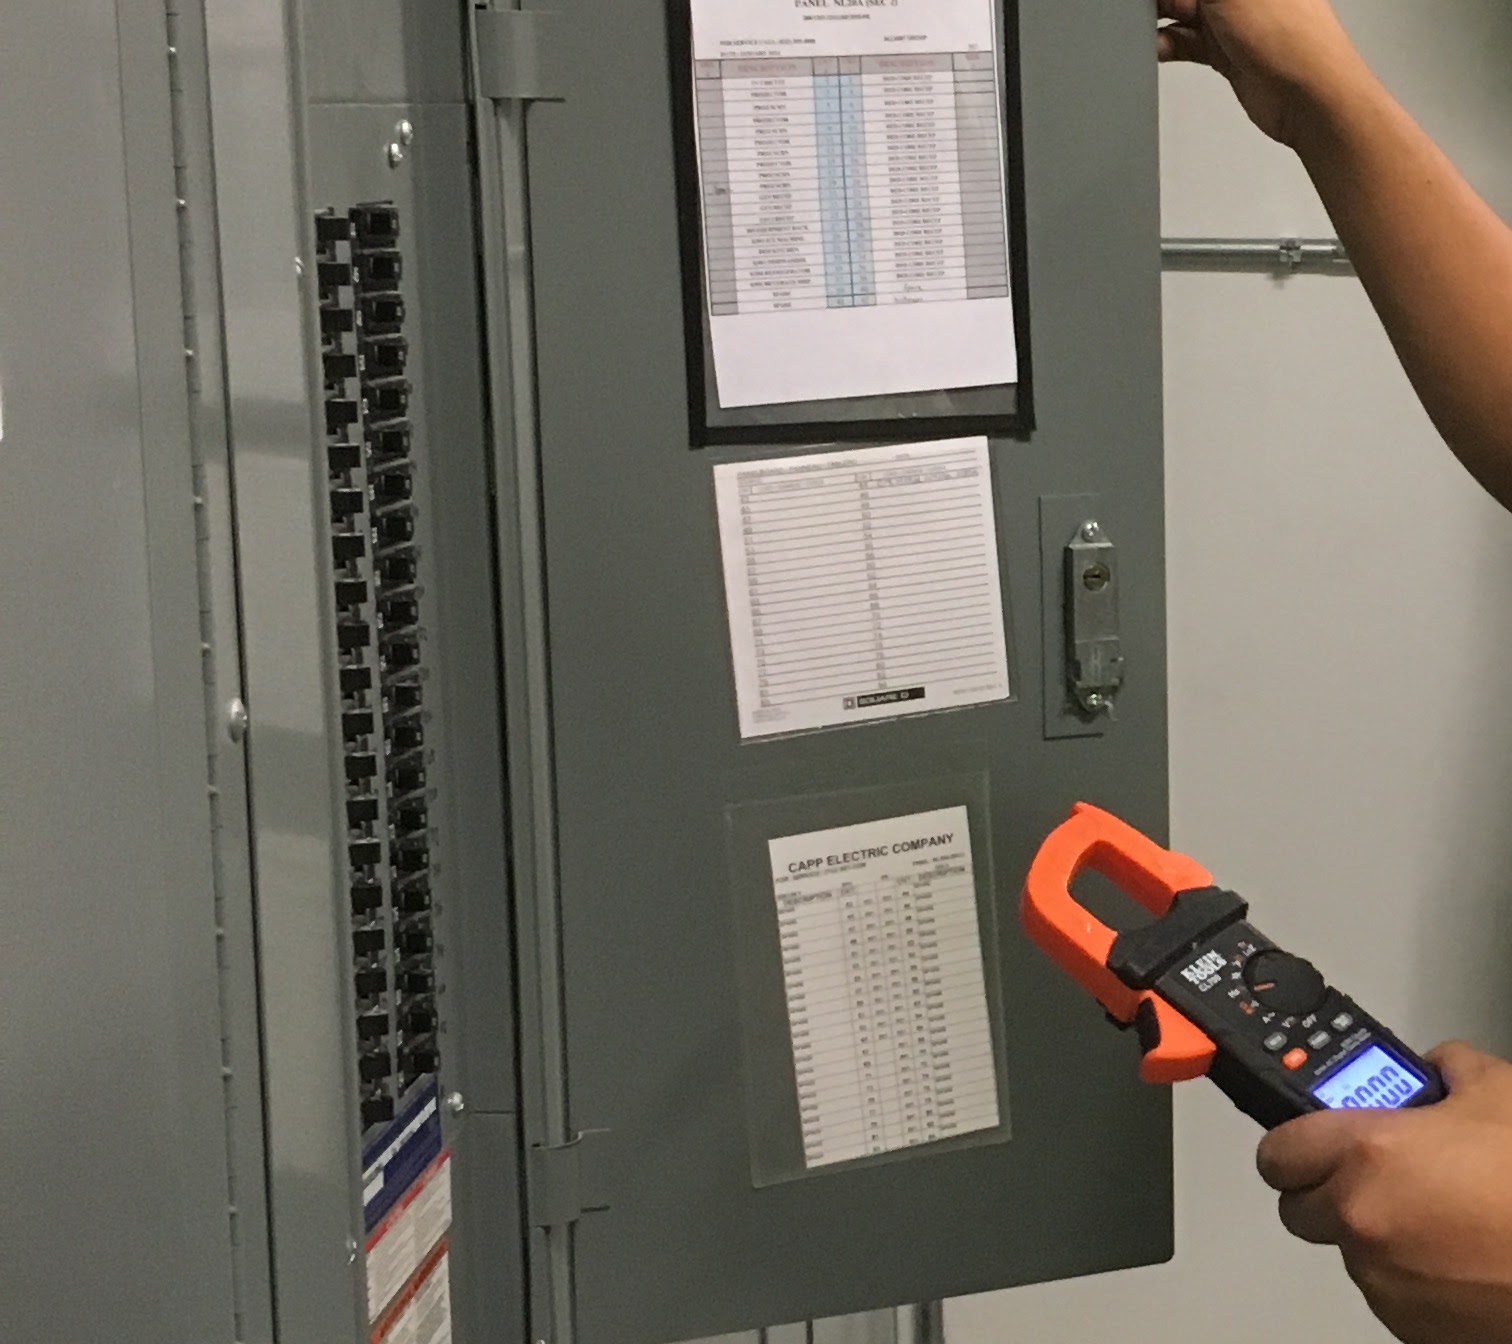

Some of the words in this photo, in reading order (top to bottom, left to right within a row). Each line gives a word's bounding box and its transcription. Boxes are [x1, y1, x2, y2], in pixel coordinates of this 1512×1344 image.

[788, 857, 823, 874] CAPP
[827, 844, 889, 867] ELECTRIC
[892, 832, 954, 855] COMPANY
